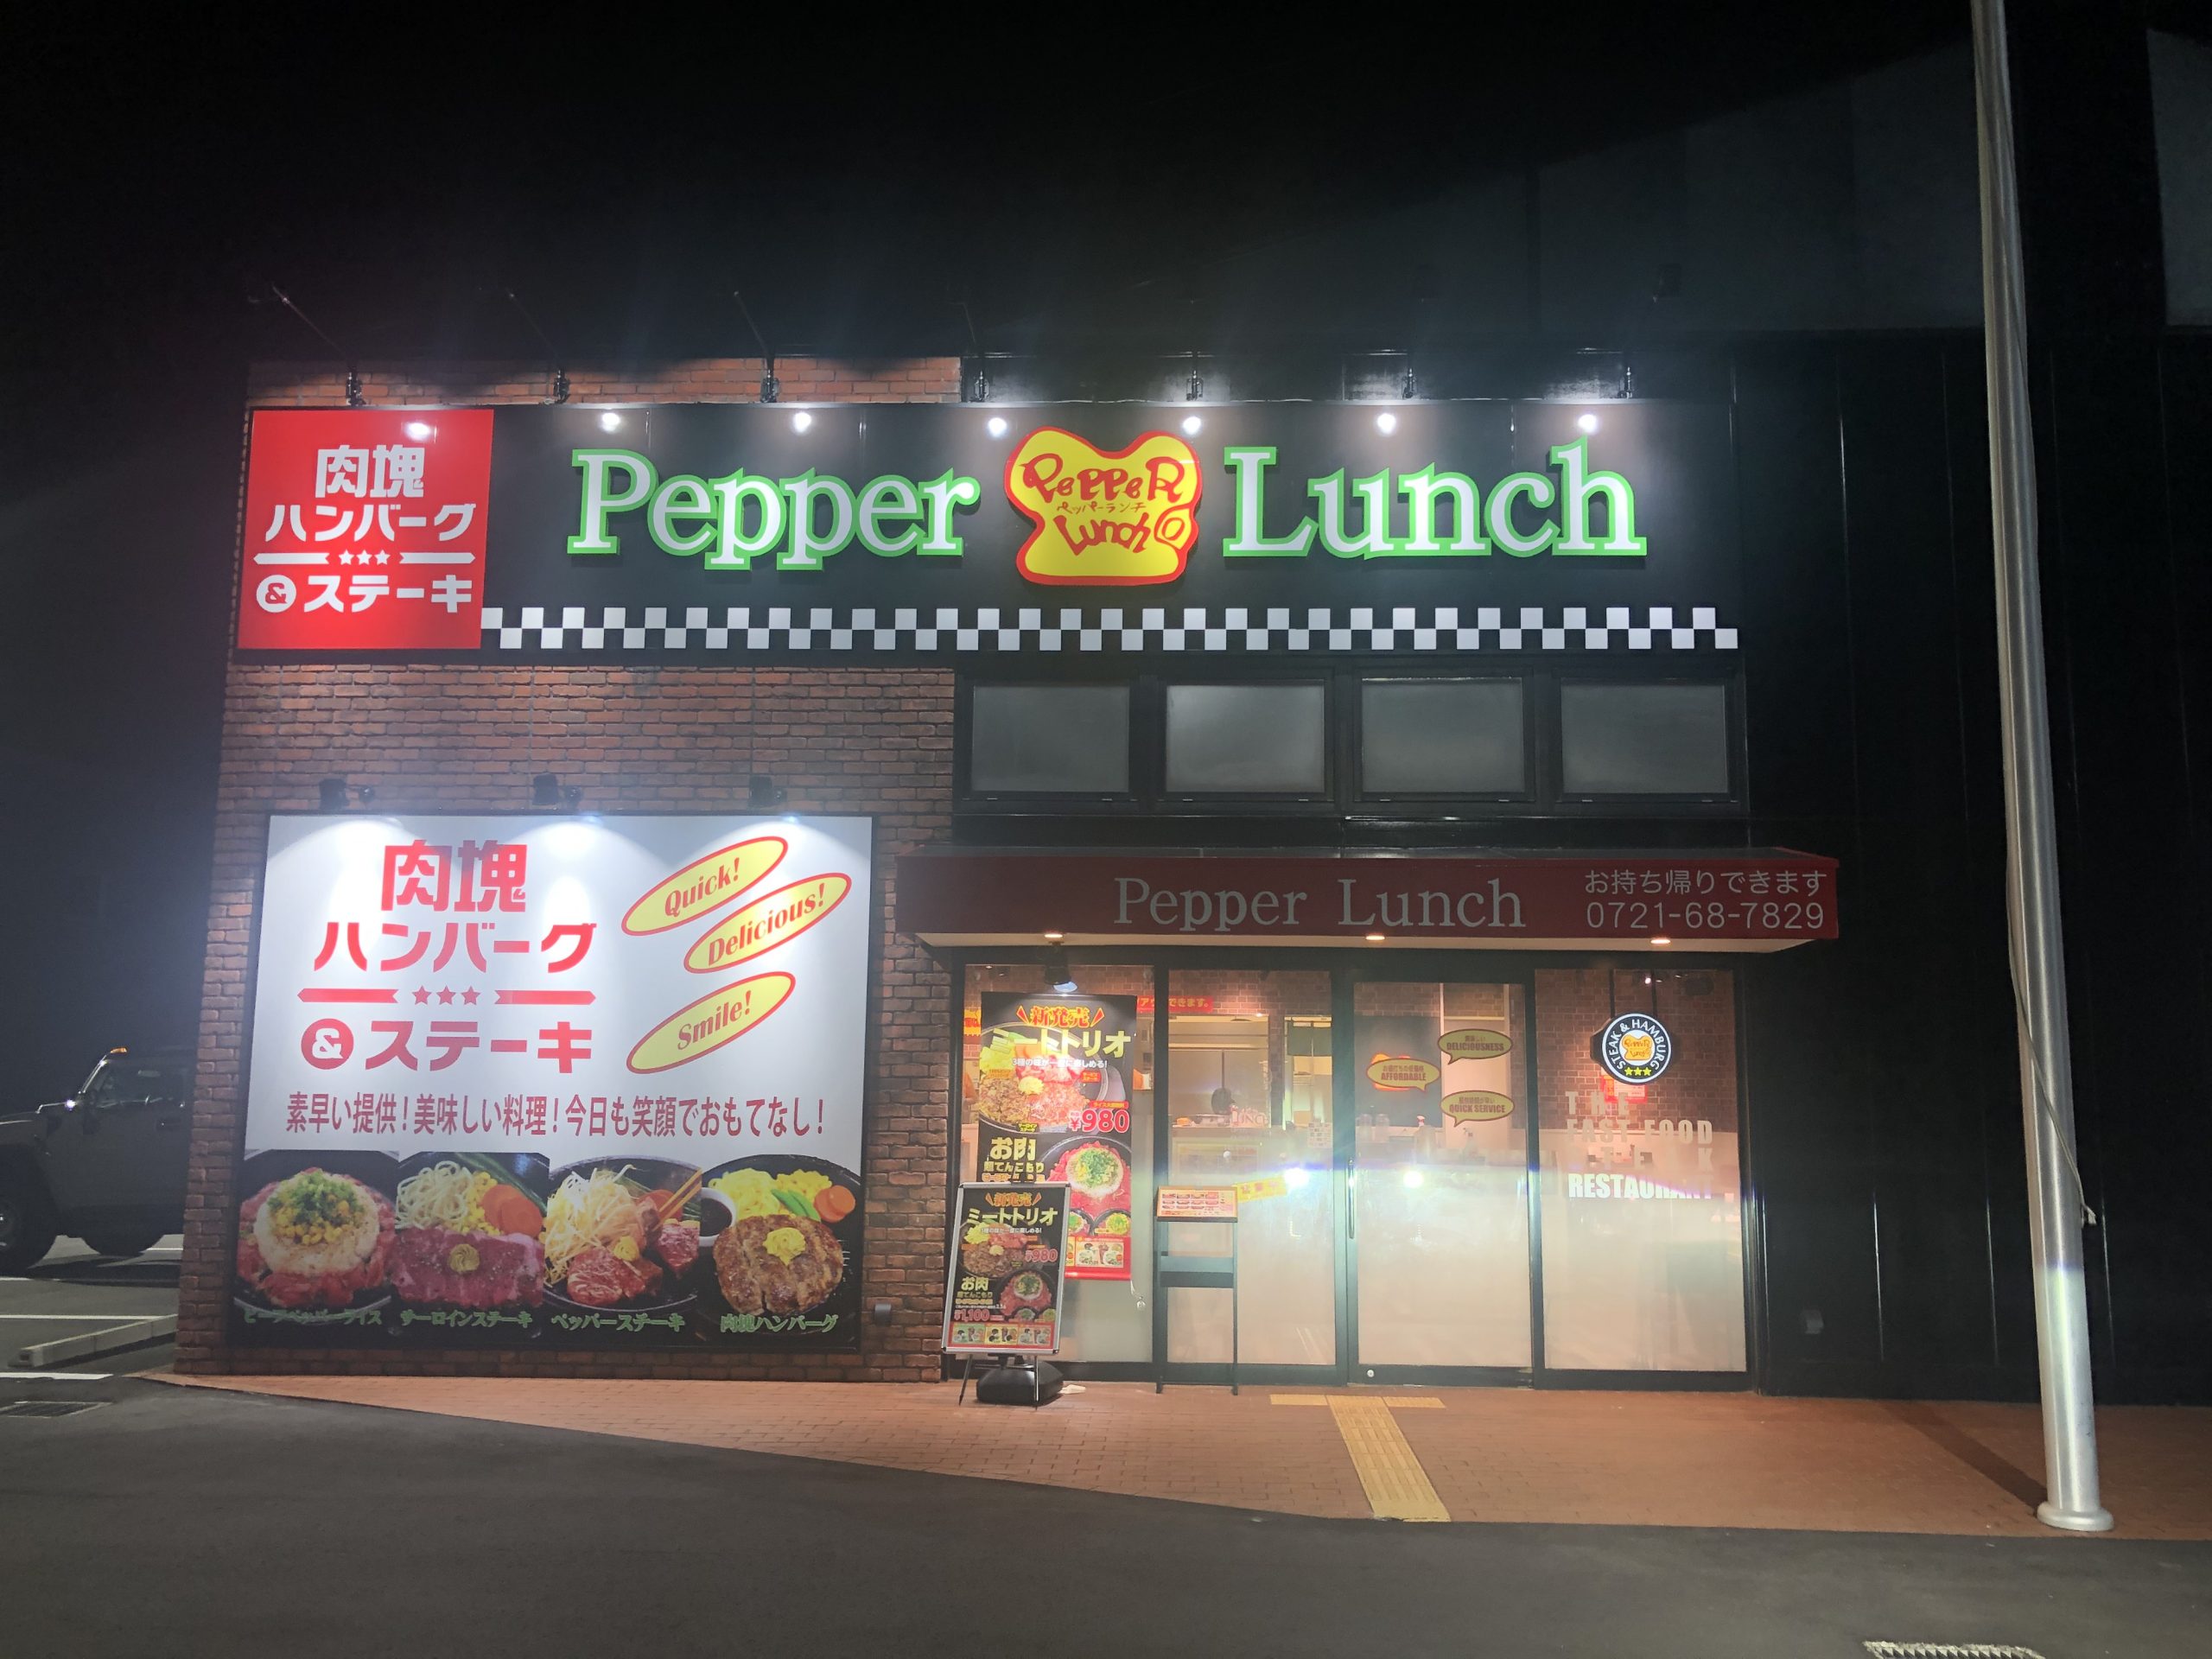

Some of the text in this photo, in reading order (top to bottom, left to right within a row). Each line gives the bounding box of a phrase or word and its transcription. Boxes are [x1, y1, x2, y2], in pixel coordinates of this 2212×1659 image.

[315, 445, 425, 499] 肉塊
[567, 435, 1648, 571] Pepper Lunch
[1056, 500, 1148, 515] ペッパーランチ
[264, 504, 477, 543] ハンバーグ
[1053, 512, 1151, 556] Lunch
[379, 838, 529, 913] 肉塊
[663, 858, 741, 918] Quick!
[1585, 869, 1827, 896] お持ち帰りできます
[1113, 877, 1527, 931] Pepper Lunch
[1586, 901, 1826, 931] 0721-68-7829
[706, 885, 826, 966] Delicious!
[313, 921, 598, 974] ハンバーグ
[676, 991, 753, 1052] Smile!
[990, 1027, 1132, 1058] ミートトリオ
[1446, 1042, 1504, 1052] DELICIOUSNESS
[1608, 1032, 1626, 1070] STEAK
[1631, 1019, 1667, 1071] HAMBURG
[1381, 1072, 1427, 1081] AFFORDABLE
[1449, 1104, 1506, 1113] QUICK SERVICE
[1566, 1090, 1630, 1116] THE
[1567, 1119, 1713, 1145] FAST FOOD
[990, 1137, 1037, 1160] お肉
[967, 1207, 1058, 1226] ミートトリオ
[961, 1276, 989, 1291] お肉
[400, 1308, 533, 1329] サーロインステーキ
[550, 1313, 685, 1332] ペッパーステーキ
[721, 1313, 839, 1333] 肉塊ハンバーグ
